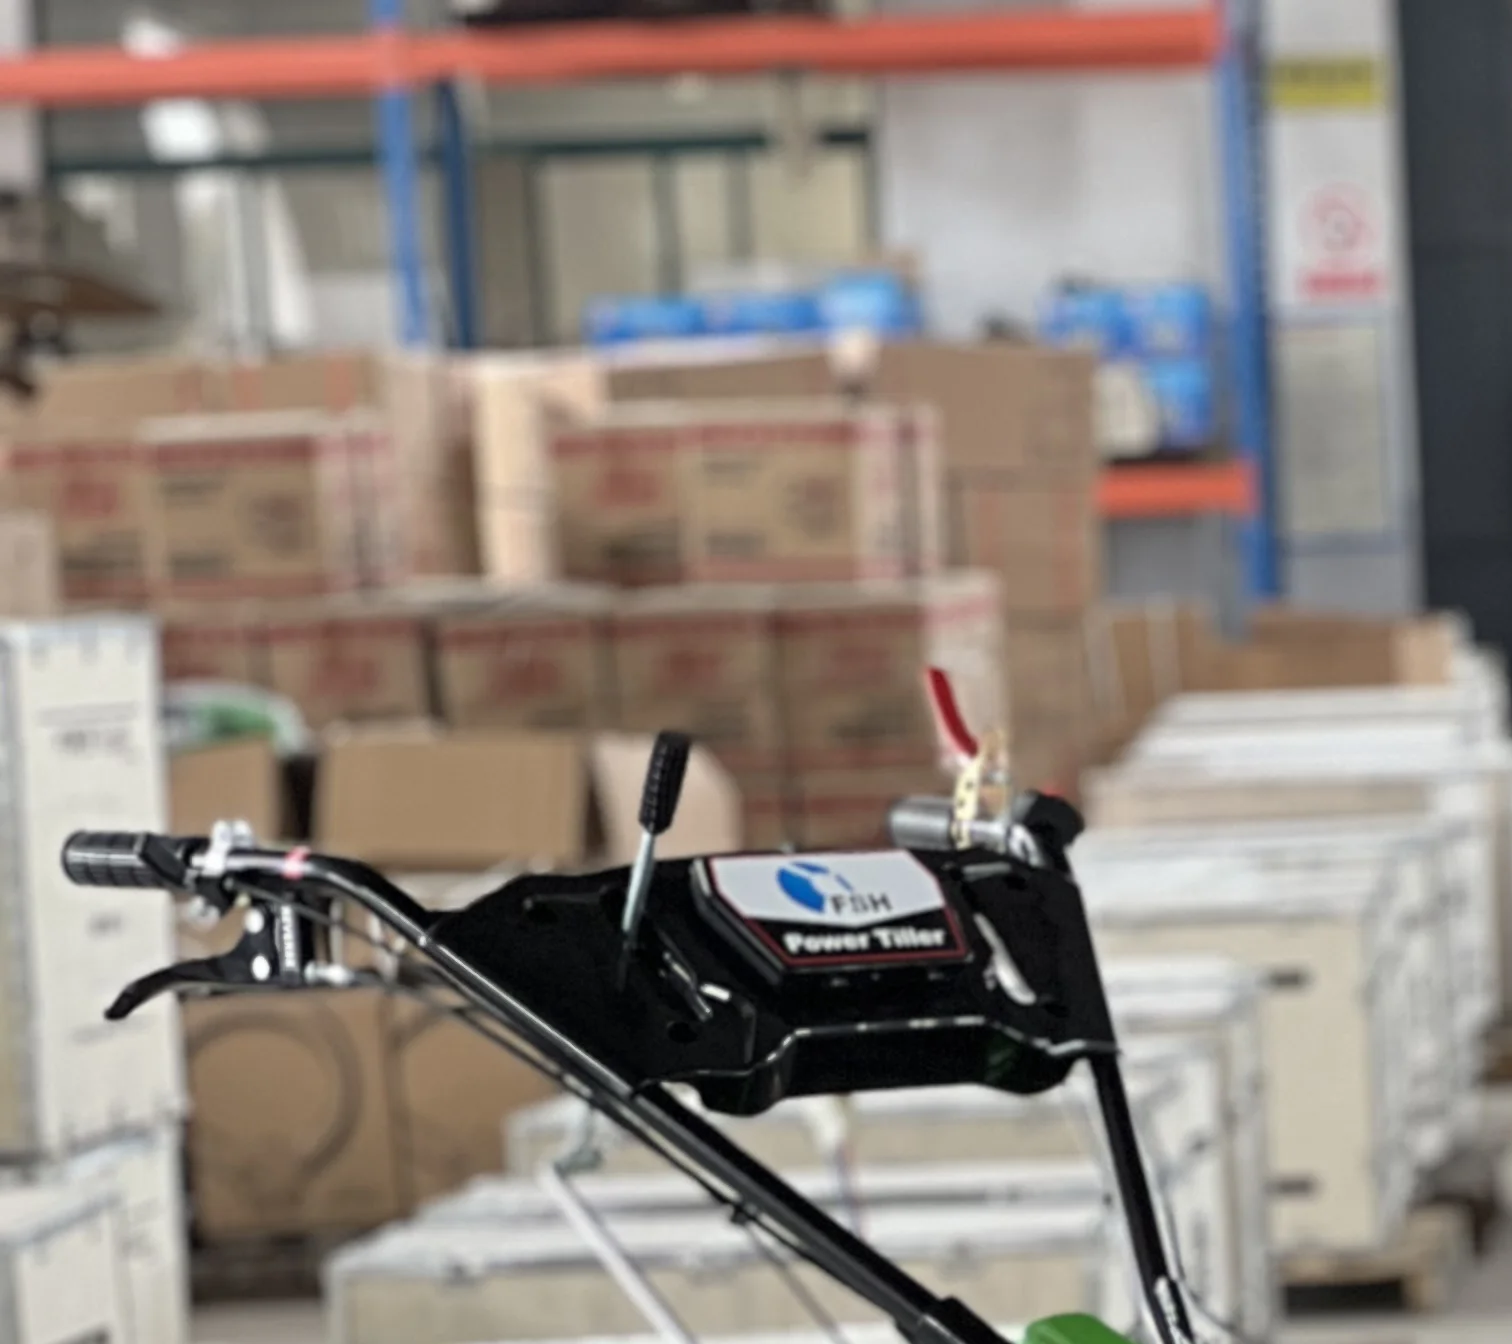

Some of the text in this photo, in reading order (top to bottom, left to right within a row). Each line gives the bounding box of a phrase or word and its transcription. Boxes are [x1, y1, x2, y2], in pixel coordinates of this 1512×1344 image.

[831, 893, 893, 914] FSH
[784, 926, 945, 954] Power Tiller
